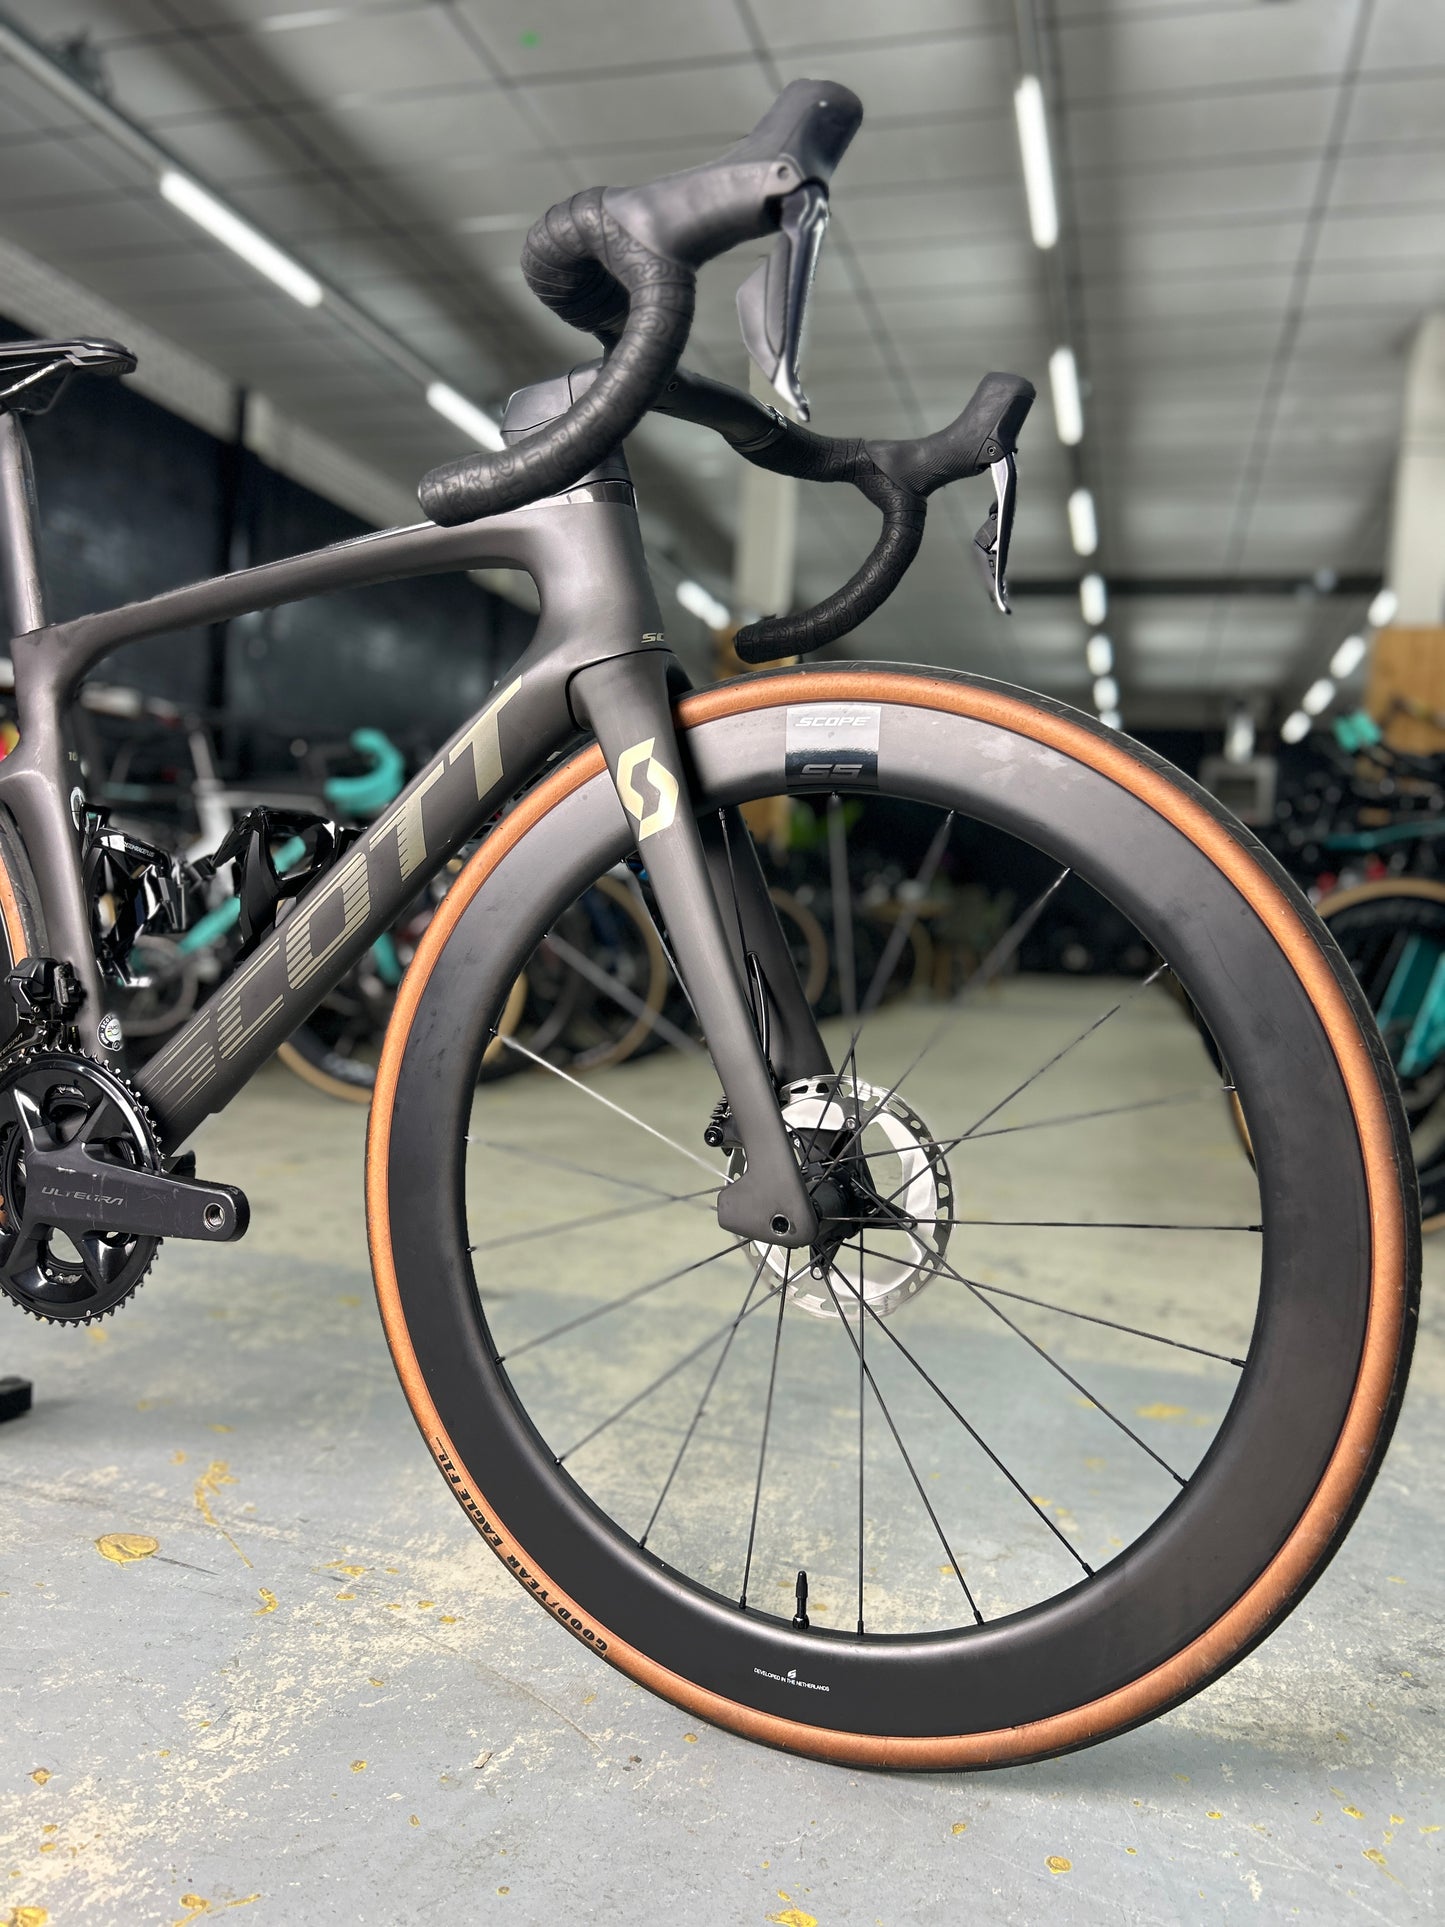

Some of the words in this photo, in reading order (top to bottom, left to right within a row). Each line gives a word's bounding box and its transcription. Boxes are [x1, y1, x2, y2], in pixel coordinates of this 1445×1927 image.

[794, 716, 871, 727] SCOPE
[138, 675, 522, 1121] SCOTT
[458, 1488, 504, 1546] EAGLE
[507, 1555, 608, 1651] GOODYEAR
[754, 1667, 781, 1681] DEVELOPED
[787, 1677, 796, 1685] THE
[796, 1681, 830, 1691] NETHERLANDS
